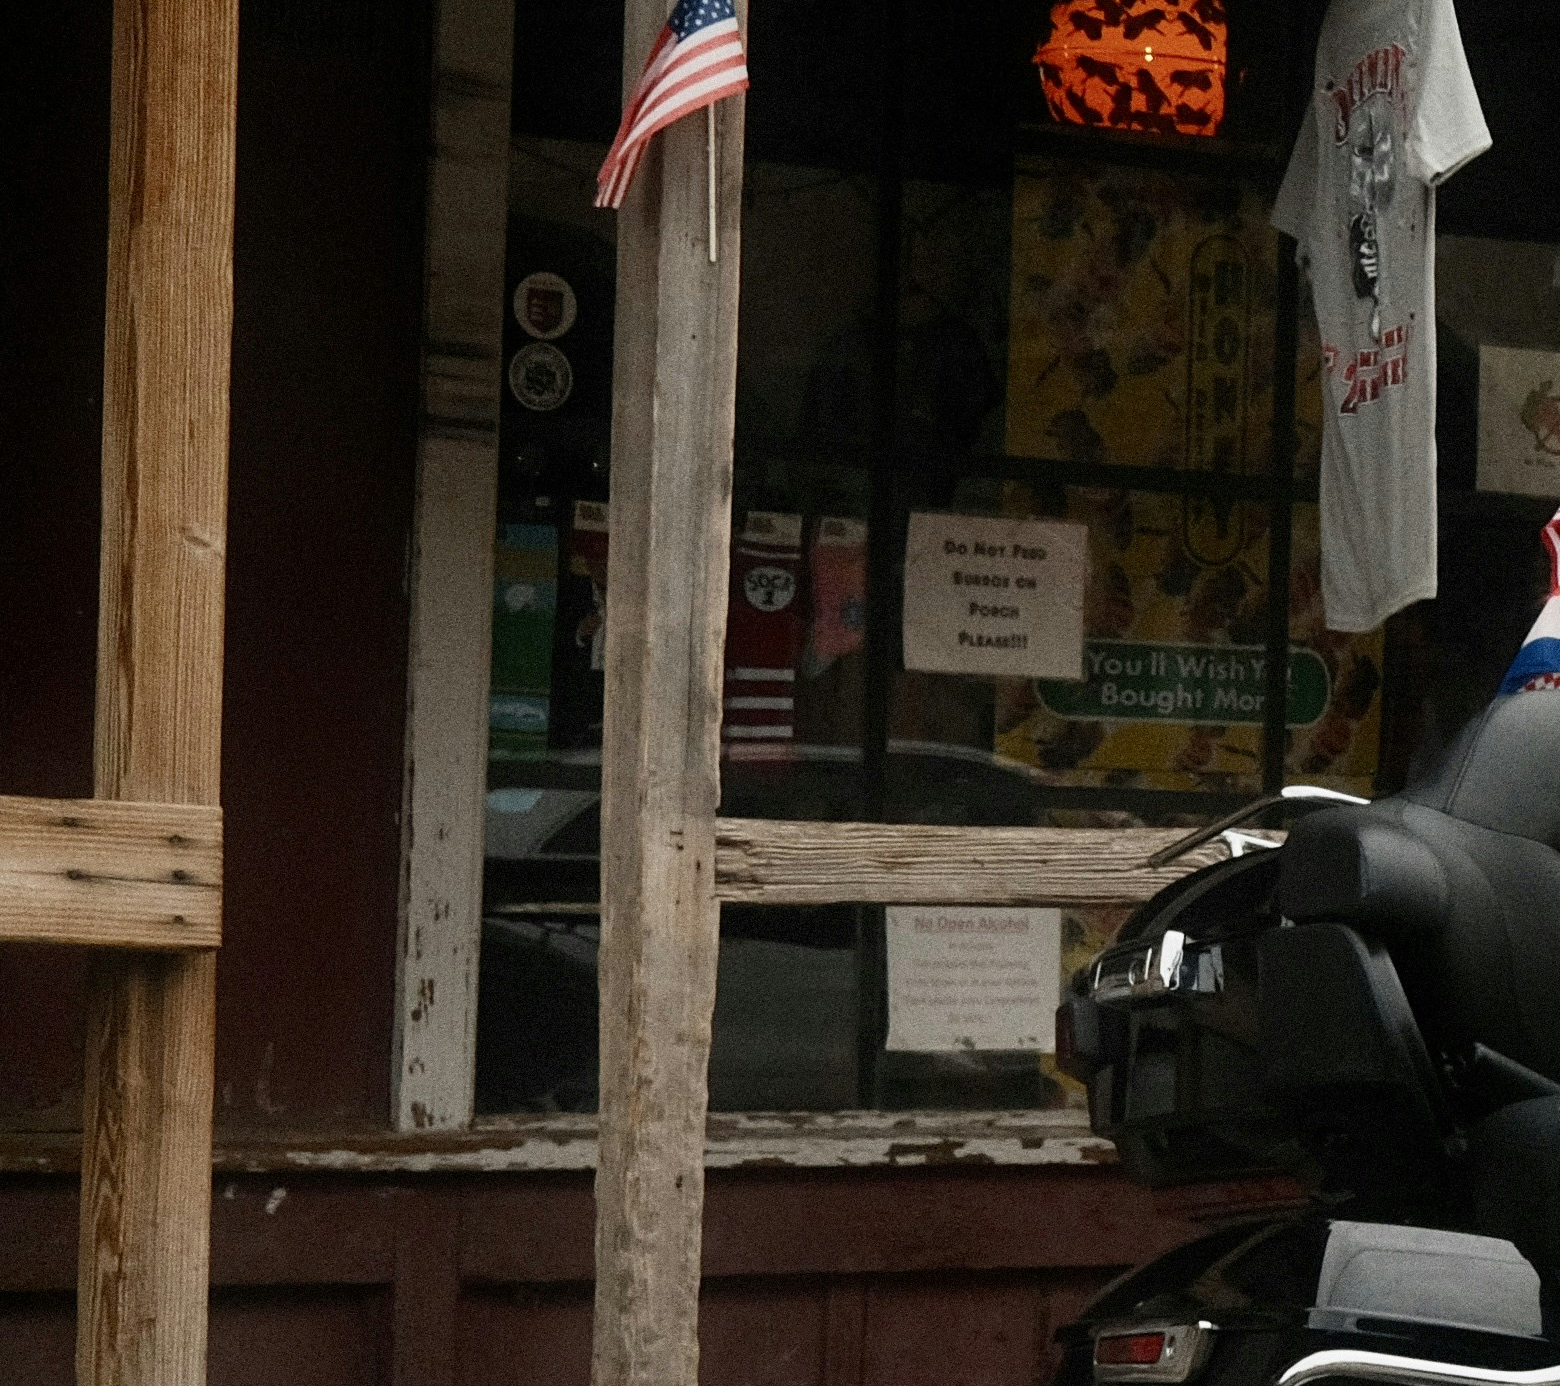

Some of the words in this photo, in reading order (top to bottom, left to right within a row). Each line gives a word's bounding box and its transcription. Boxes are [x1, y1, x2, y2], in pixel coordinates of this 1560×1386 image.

[1176, 655, 1245, 680] Wish
[1101, 682, 1204, 714] Bought
[1213, 687, 1266, 711] Mor
[937, 915, 975, 932] Open
[979, 915, 1030, 932] Alcohol
